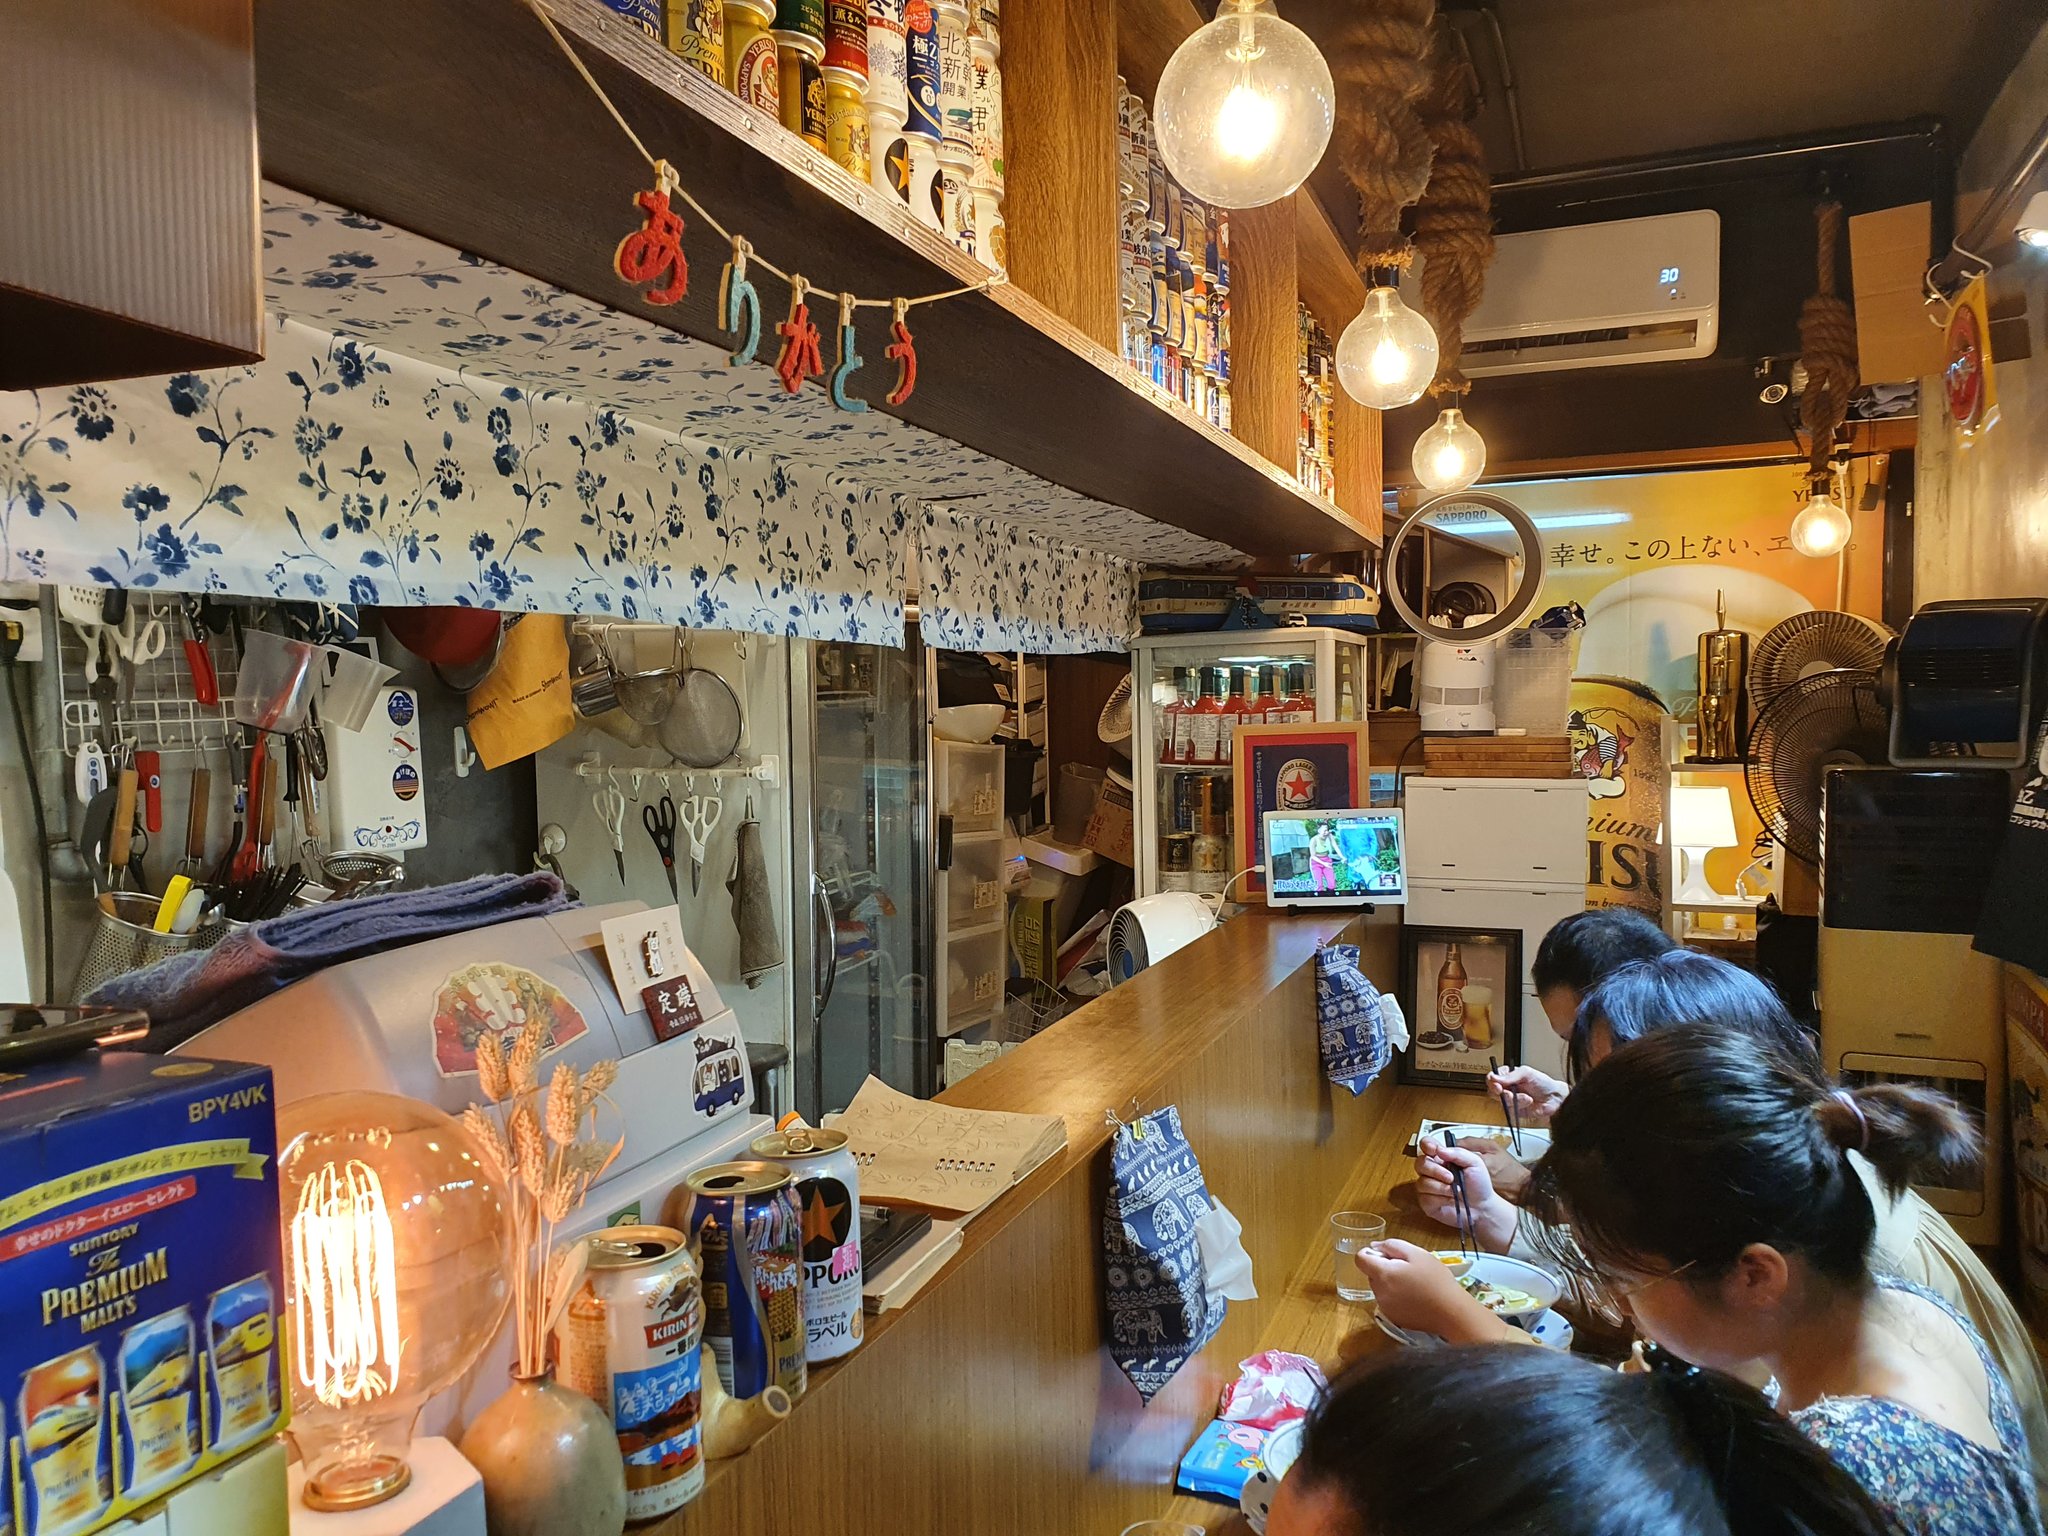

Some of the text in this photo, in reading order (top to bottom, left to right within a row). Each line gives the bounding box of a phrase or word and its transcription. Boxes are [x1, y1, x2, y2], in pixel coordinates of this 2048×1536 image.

[1660, 267, 1679, 283] 30
[1792, 486, 1855, 503] YESU
[1436, 509, 1488, 523] SAPPORO
[1550, 535, 1857, 568] 幸せ。この上ない、ヱ。
[188, 1084, 267, 1123] BPY4VK
[69, 1222, 139, 1257] SUNTORY
[41, 1246, 168, 1326] PREMIUM
[653, 1317, 688, 1342] KIRIN
[806, 1310, 848, 1327] ポロ生ビール
[807, 1321, 848, 1344] ラベル
